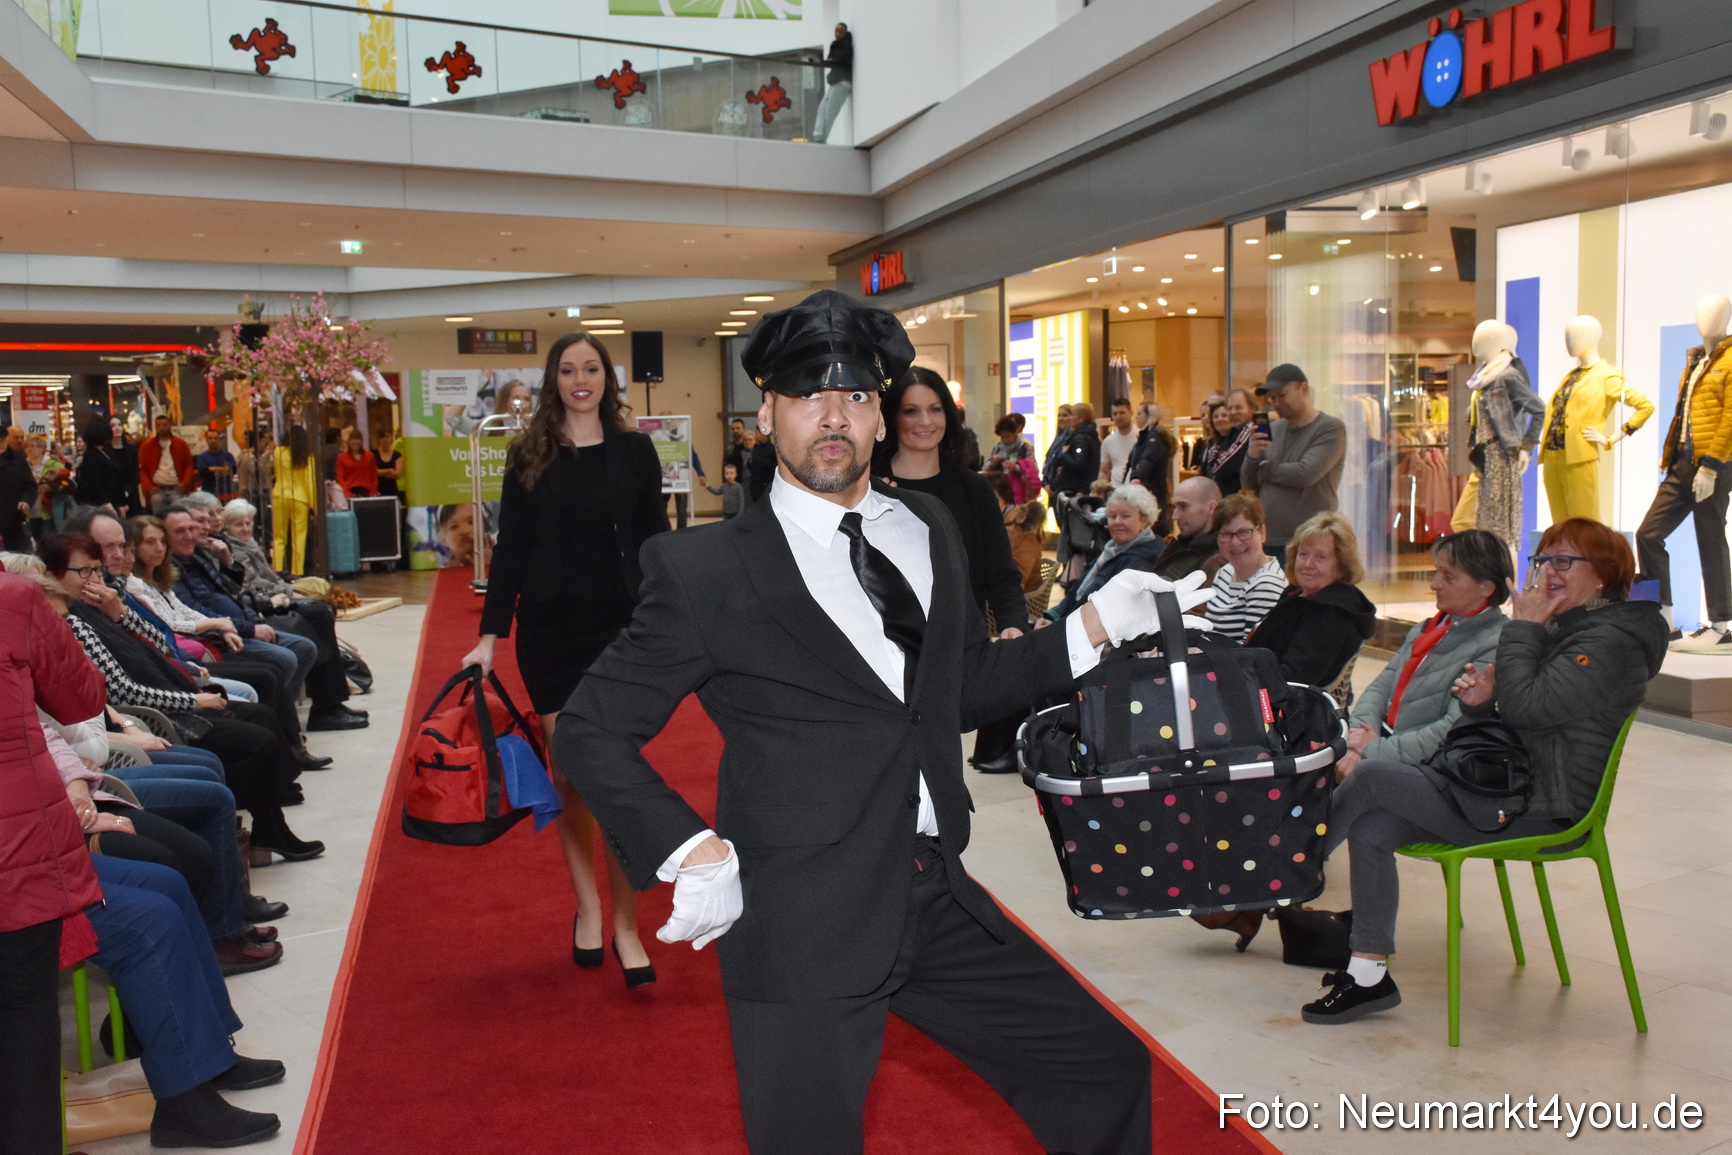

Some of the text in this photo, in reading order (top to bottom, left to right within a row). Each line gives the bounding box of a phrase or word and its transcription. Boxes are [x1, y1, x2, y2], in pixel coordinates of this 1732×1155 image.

[1368, 0, 1616, 127] WÖHRL
[861, 251, 906, 297] WÖHRL
[28, 421, 45, 433] dm
